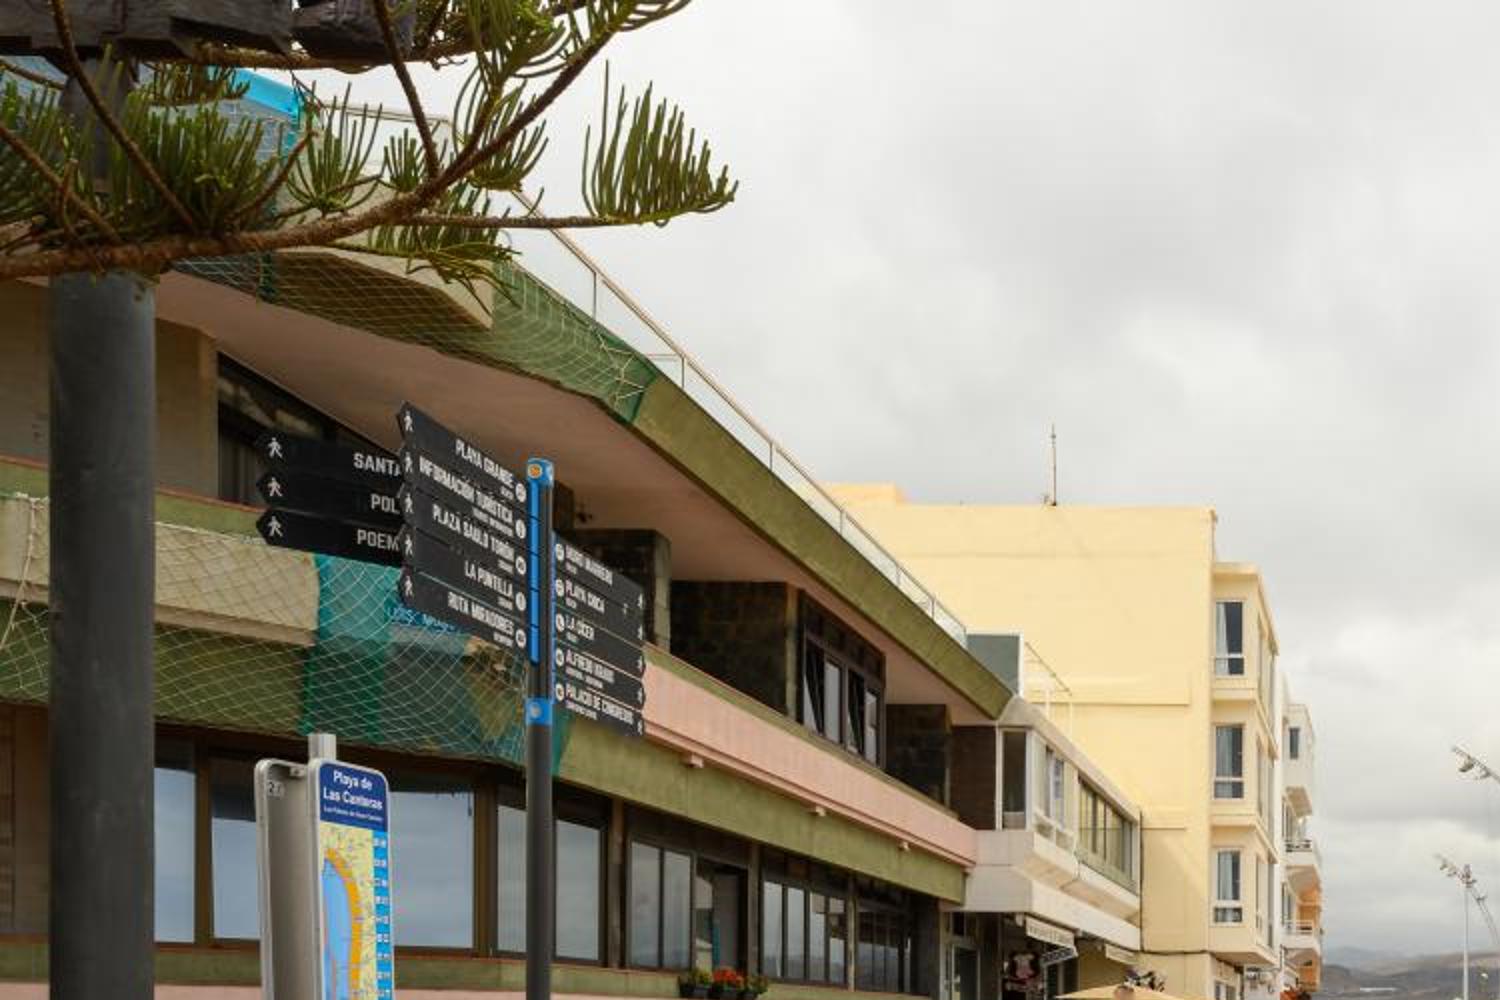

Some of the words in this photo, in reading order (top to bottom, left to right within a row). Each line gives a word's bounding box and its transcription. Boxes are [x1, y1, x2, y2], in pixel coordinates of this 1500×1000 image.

[455, 438, 483, 470] PLAYA
[432, 503, 461, 534] PLAZA
[464, 559, 477, 581] LA
[447, 591, 470, 615] RUTA
[565, 682, 593, 708] PALACIO
[333, 770, 359, 789] Playa
[360, 777, 373, 791] de
[322, 786, 340, 802] Las
[341, 790, 383, 811] Canteras
